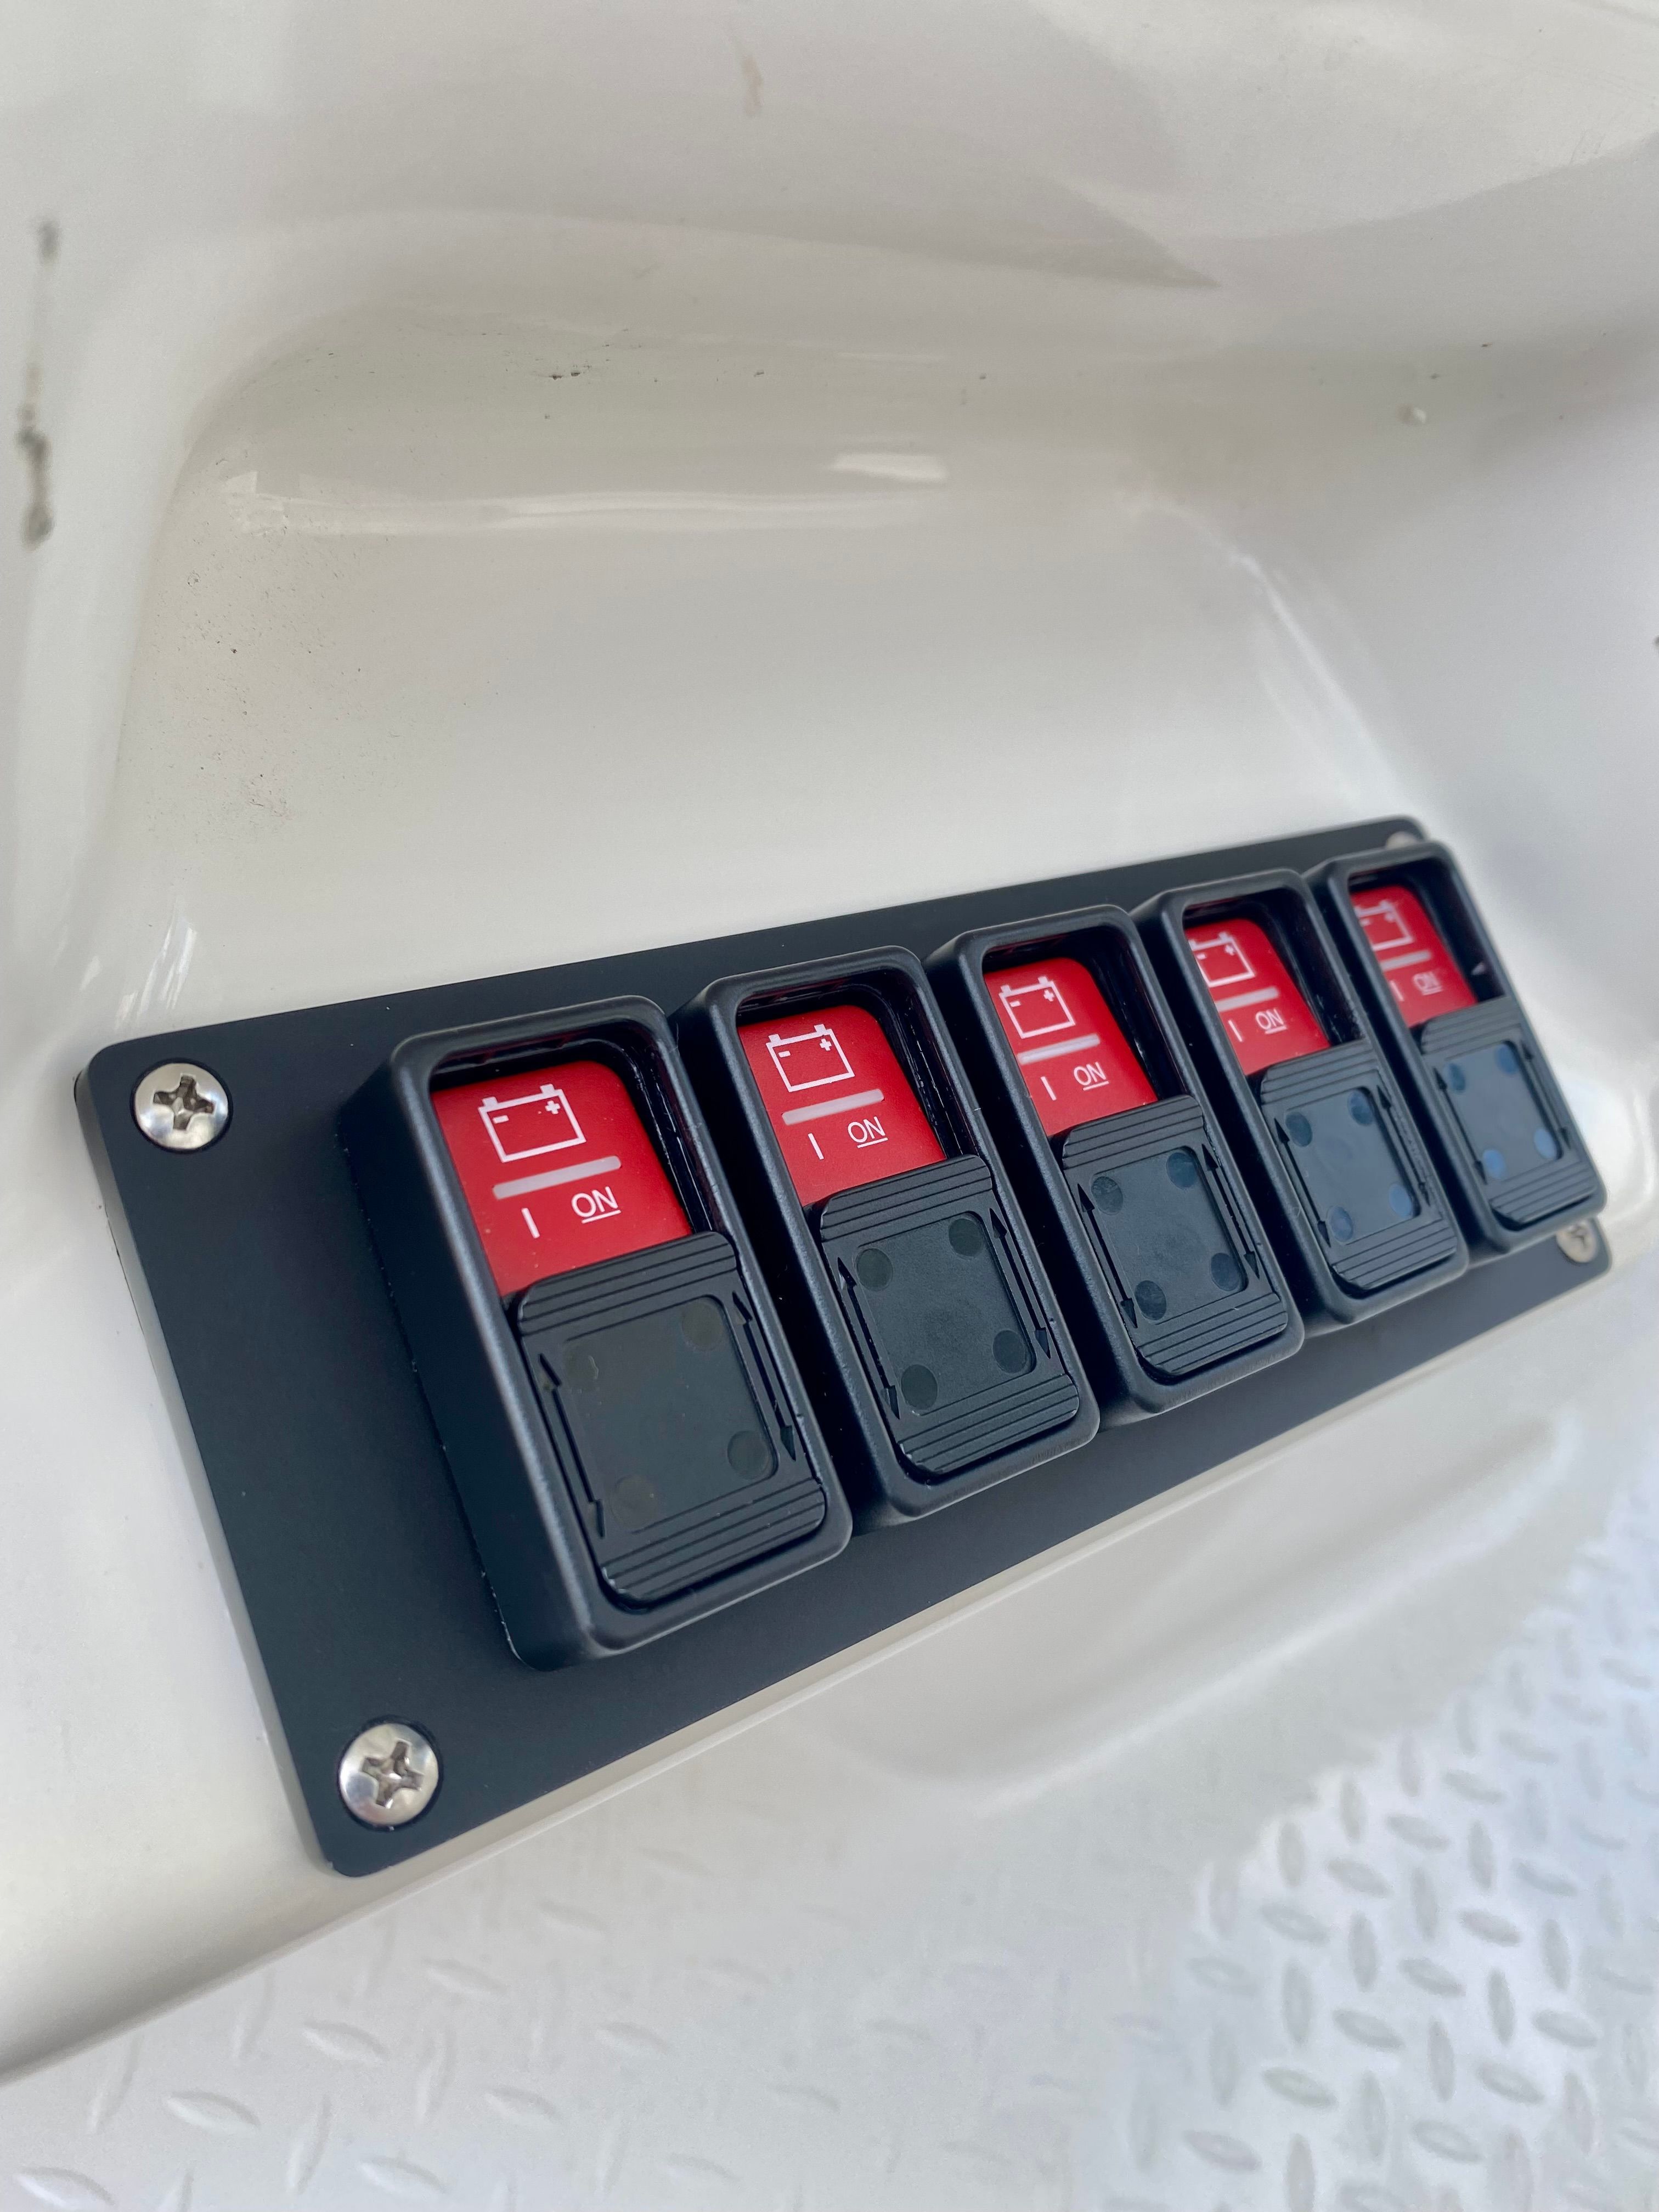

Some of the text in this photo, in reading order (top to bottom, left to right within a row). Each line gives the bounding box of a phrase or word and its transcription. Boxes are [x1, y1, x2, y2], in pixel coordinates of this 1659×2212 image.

[1413, 972, 1440, 991] ON
[1255, 1008, 1284, 1030] ON
[1074, 1062, 1107, 1086] ON
[848, 1116, 885, 1143] ON
[571, 1186, 618, 1217] ON
